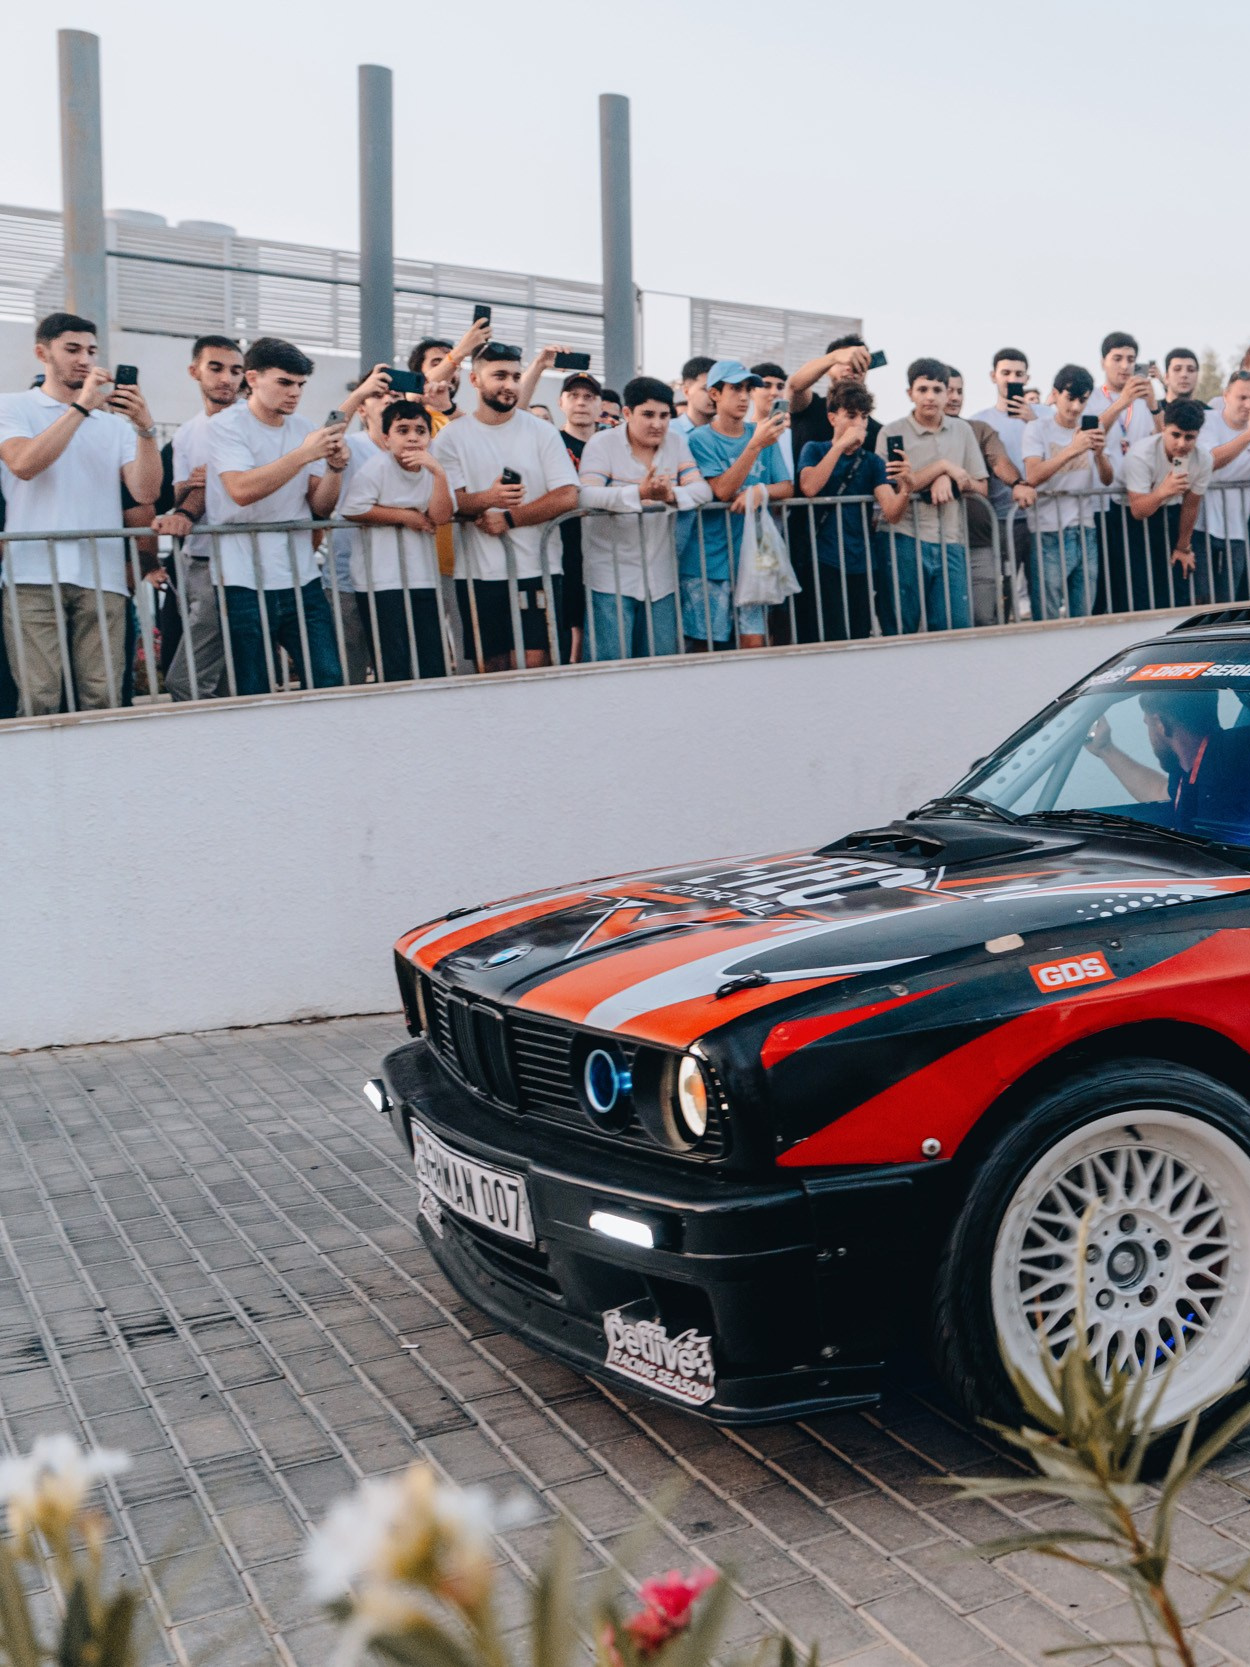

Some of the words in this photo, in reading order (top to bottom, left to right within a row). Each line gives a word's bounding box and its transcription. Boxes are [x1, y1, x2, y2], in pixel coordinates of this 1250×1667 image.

[1150, 665, 1207, 678] DRIFT
[728, 896, 777, 917] OIL
[1037, 957, 1107, 987] GDS
[480, 1174, 520, 1232] 007
[611, 1349, 658, 1379] RACING
[656, 1368, 714, 1401] SEASON
